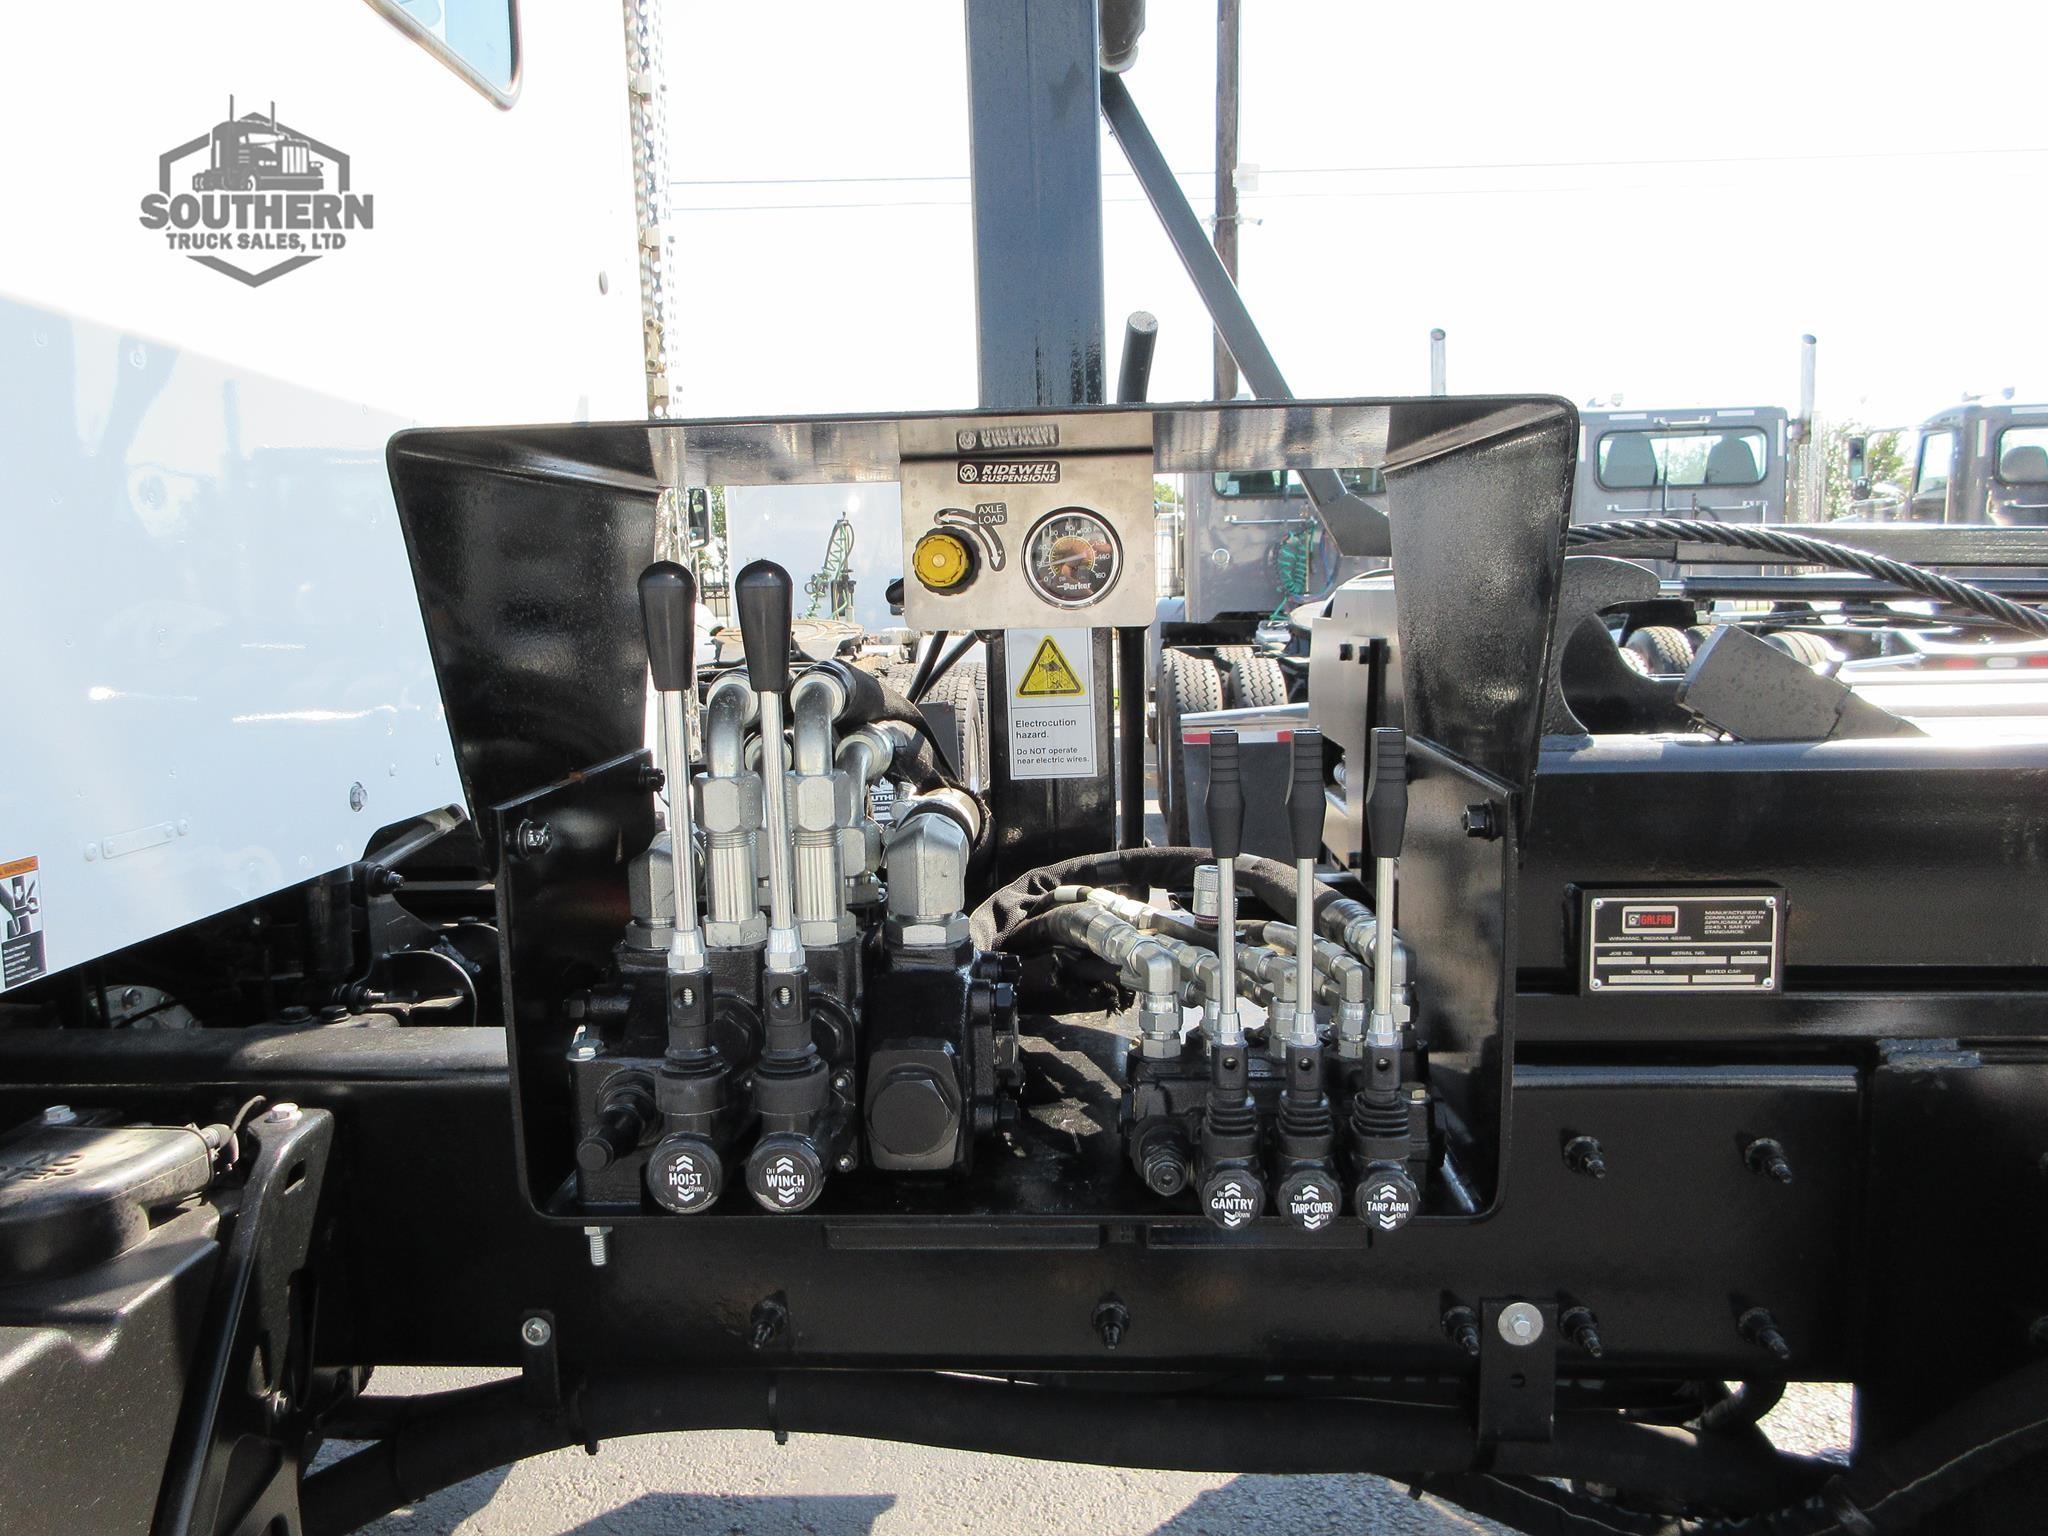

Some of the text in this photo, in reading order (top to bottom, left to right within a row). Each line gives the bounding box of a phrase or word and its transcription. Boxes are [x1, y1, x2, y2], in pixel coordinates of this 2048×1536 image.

[981, 464, 1057, 475] RIDEWELL
[981, 474, 1056, 482] SUSPENSIONS
[978, 504, 1003, 514] AXLE
[978, 515, 1004, 525] LOAD
[1063, 581, 1092, 591] Parker
[1015, 718, 1077, 728] Electrocution
[1016, 731, 1049, 739] hazard.
[1016, 747, 1078, 757] Do NOT operate
[1036, 756, 1064, 764] electric
[1066, 755, 1090, 763] wires.
[1641, 914, 1673, 925] GALFAB
[669, 1172, 702, 1186] HOIST
[766, 1174, 805, 1188] WINCH
[1211, 1197, 1254, 1210] GANTRY
[1290, 1201, 1333, 1214] TARP COVER
[1366, 1201, 1409, 1212] TARP ARM
